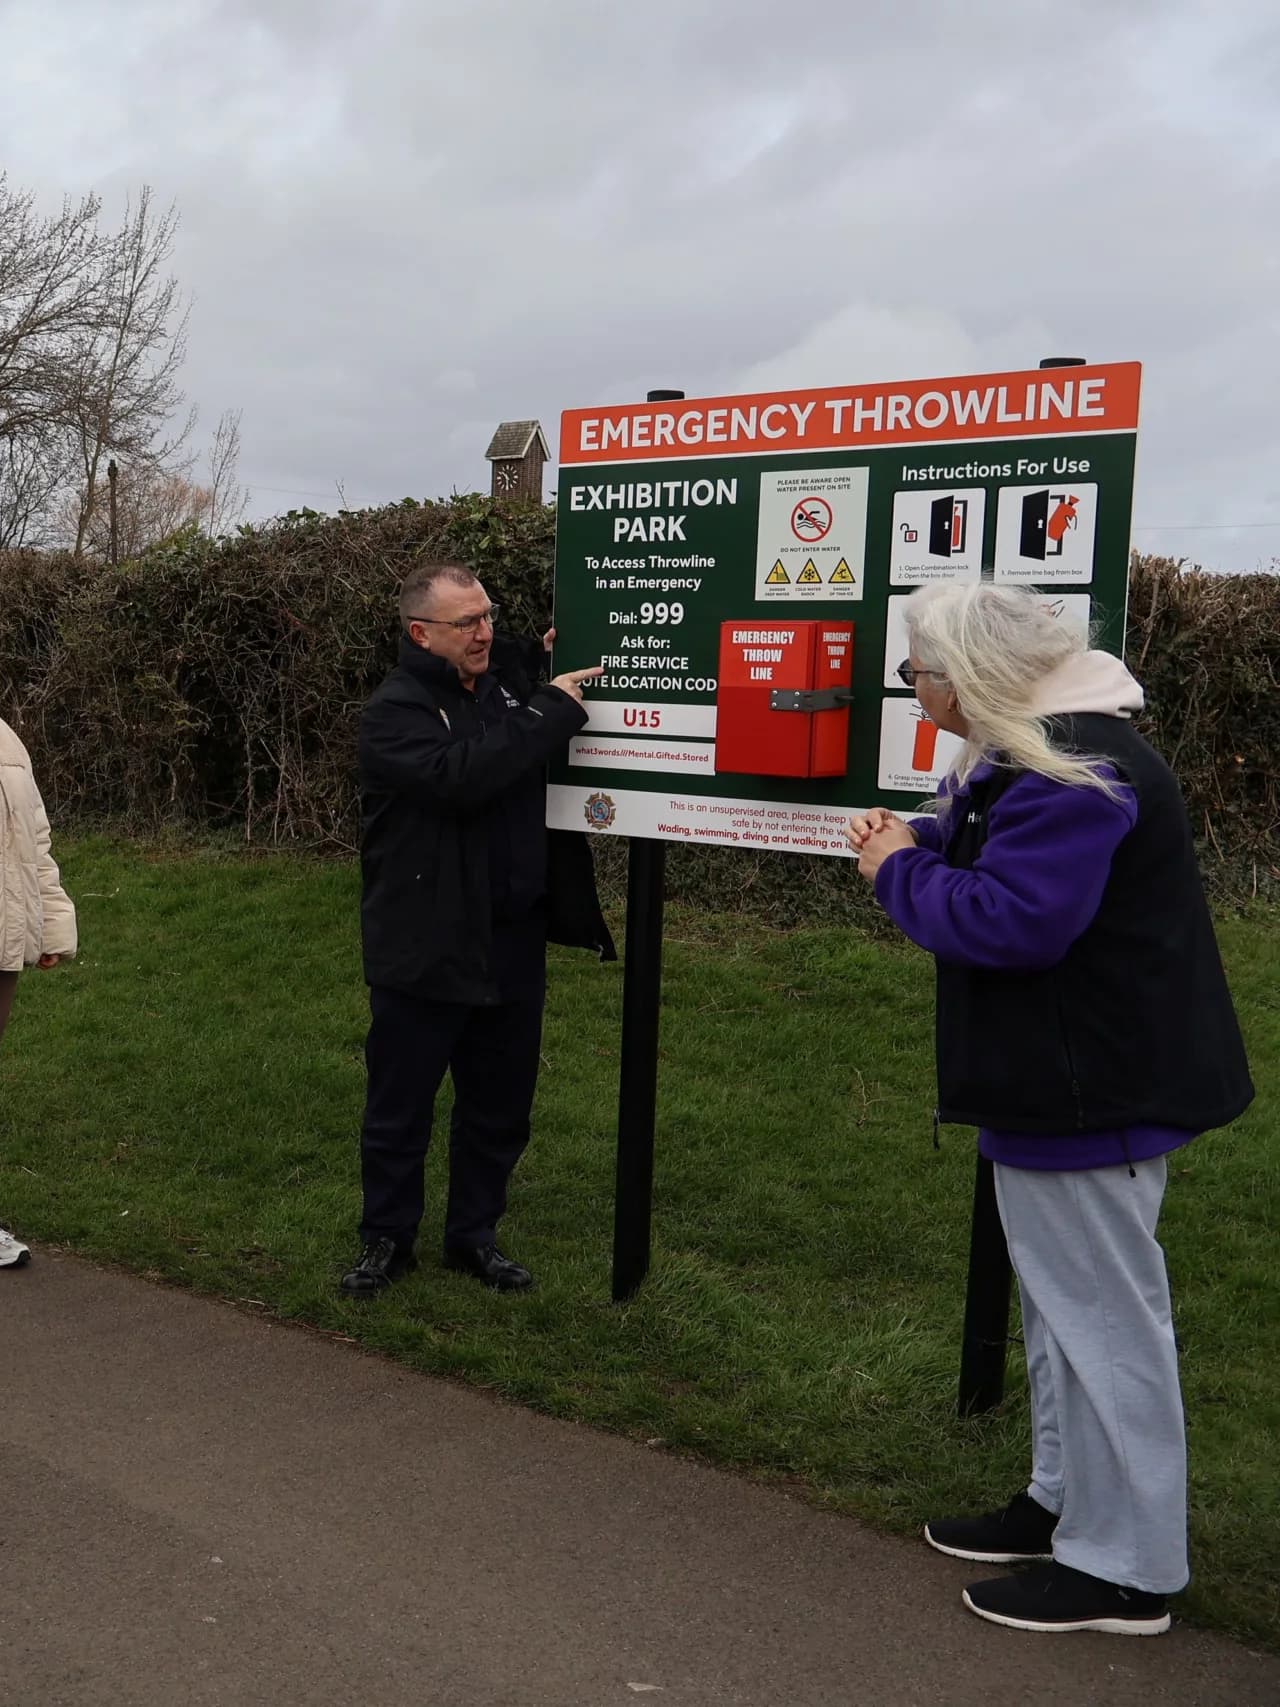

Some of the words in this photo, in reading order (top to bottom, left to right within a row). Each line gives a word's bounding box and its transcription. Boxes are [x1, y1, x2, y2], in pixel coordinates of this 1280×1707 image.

[580, 402, 816, 451] EMERGENCY
[825, 378, 1106, 433] THROWLINE
[902, 462, 1011, 481] Instructions
[1017, 460, 1048, 476] For
[1053, 457, 1090, 475] Use
[798, 484, 825, 492] PRESENT
[810, 477, 832, 485] AWARE
[570, 478, 738, 511] EXHIBITION
[613, 515, 687, 543] PARK
[585, 556, 600, 569] To
[602, 555, 645, 569] Access
[649, 555, 716, 568] Throwline
[595, 576, 607, 588] in
[609, 579, 625, 588] an
[627, 576, 701, 592] Emergency
[609, 612, 637, 624] Dial:
[640, 602, 684, 624] 999
[620, 636, 645, 648] Ask
[647, 636, 670, 648] for:
[732, 631, 795, 644] EMERGENCY
[822, 632, 851, 642] EMERGENCY
[743, 649, 782, 662] THROW
[827, 646, 846, 655] THROW
[600, 655, 629, 668] FIRE
[631, 656, 689, 669] SERVICE
[830, 659, 841, 669] LINE
[750, 667, 773, 680] LINE
[577, 675, 608, 687] OTE
[611, 676, 682, 691] LOCATION
[685, 678, 717, 691] COD
[624, 709, 661, 728] U15
[575, 747, 709, 762] what3words///Mental.Gifted.Stored
[670, 801, 685, 810] This
[688, 802, 694, 811] is
[696, 804, 707, 812] an
[709, 805, 765, 817] unsupervised
[767, 809, 789, 820] area,
[791, 811, 822, 821] please
[824, 813, 846, 826] keep
[731, 818, 750, 828] safe
[752, 819, 763, 831] by
[765, 822, 779, 831] not
[781, 823, 817, 836] entering
[820, 825, 834, 836] the
[658, 823, 691, 836] Wading,
[694, 827, 740, 841] swimming,
[742, 831, 769, 844] diving
[771, 834, 789, 844] and
[792, 837, 828, 849] walking
[830, 841, 842, 849] on
